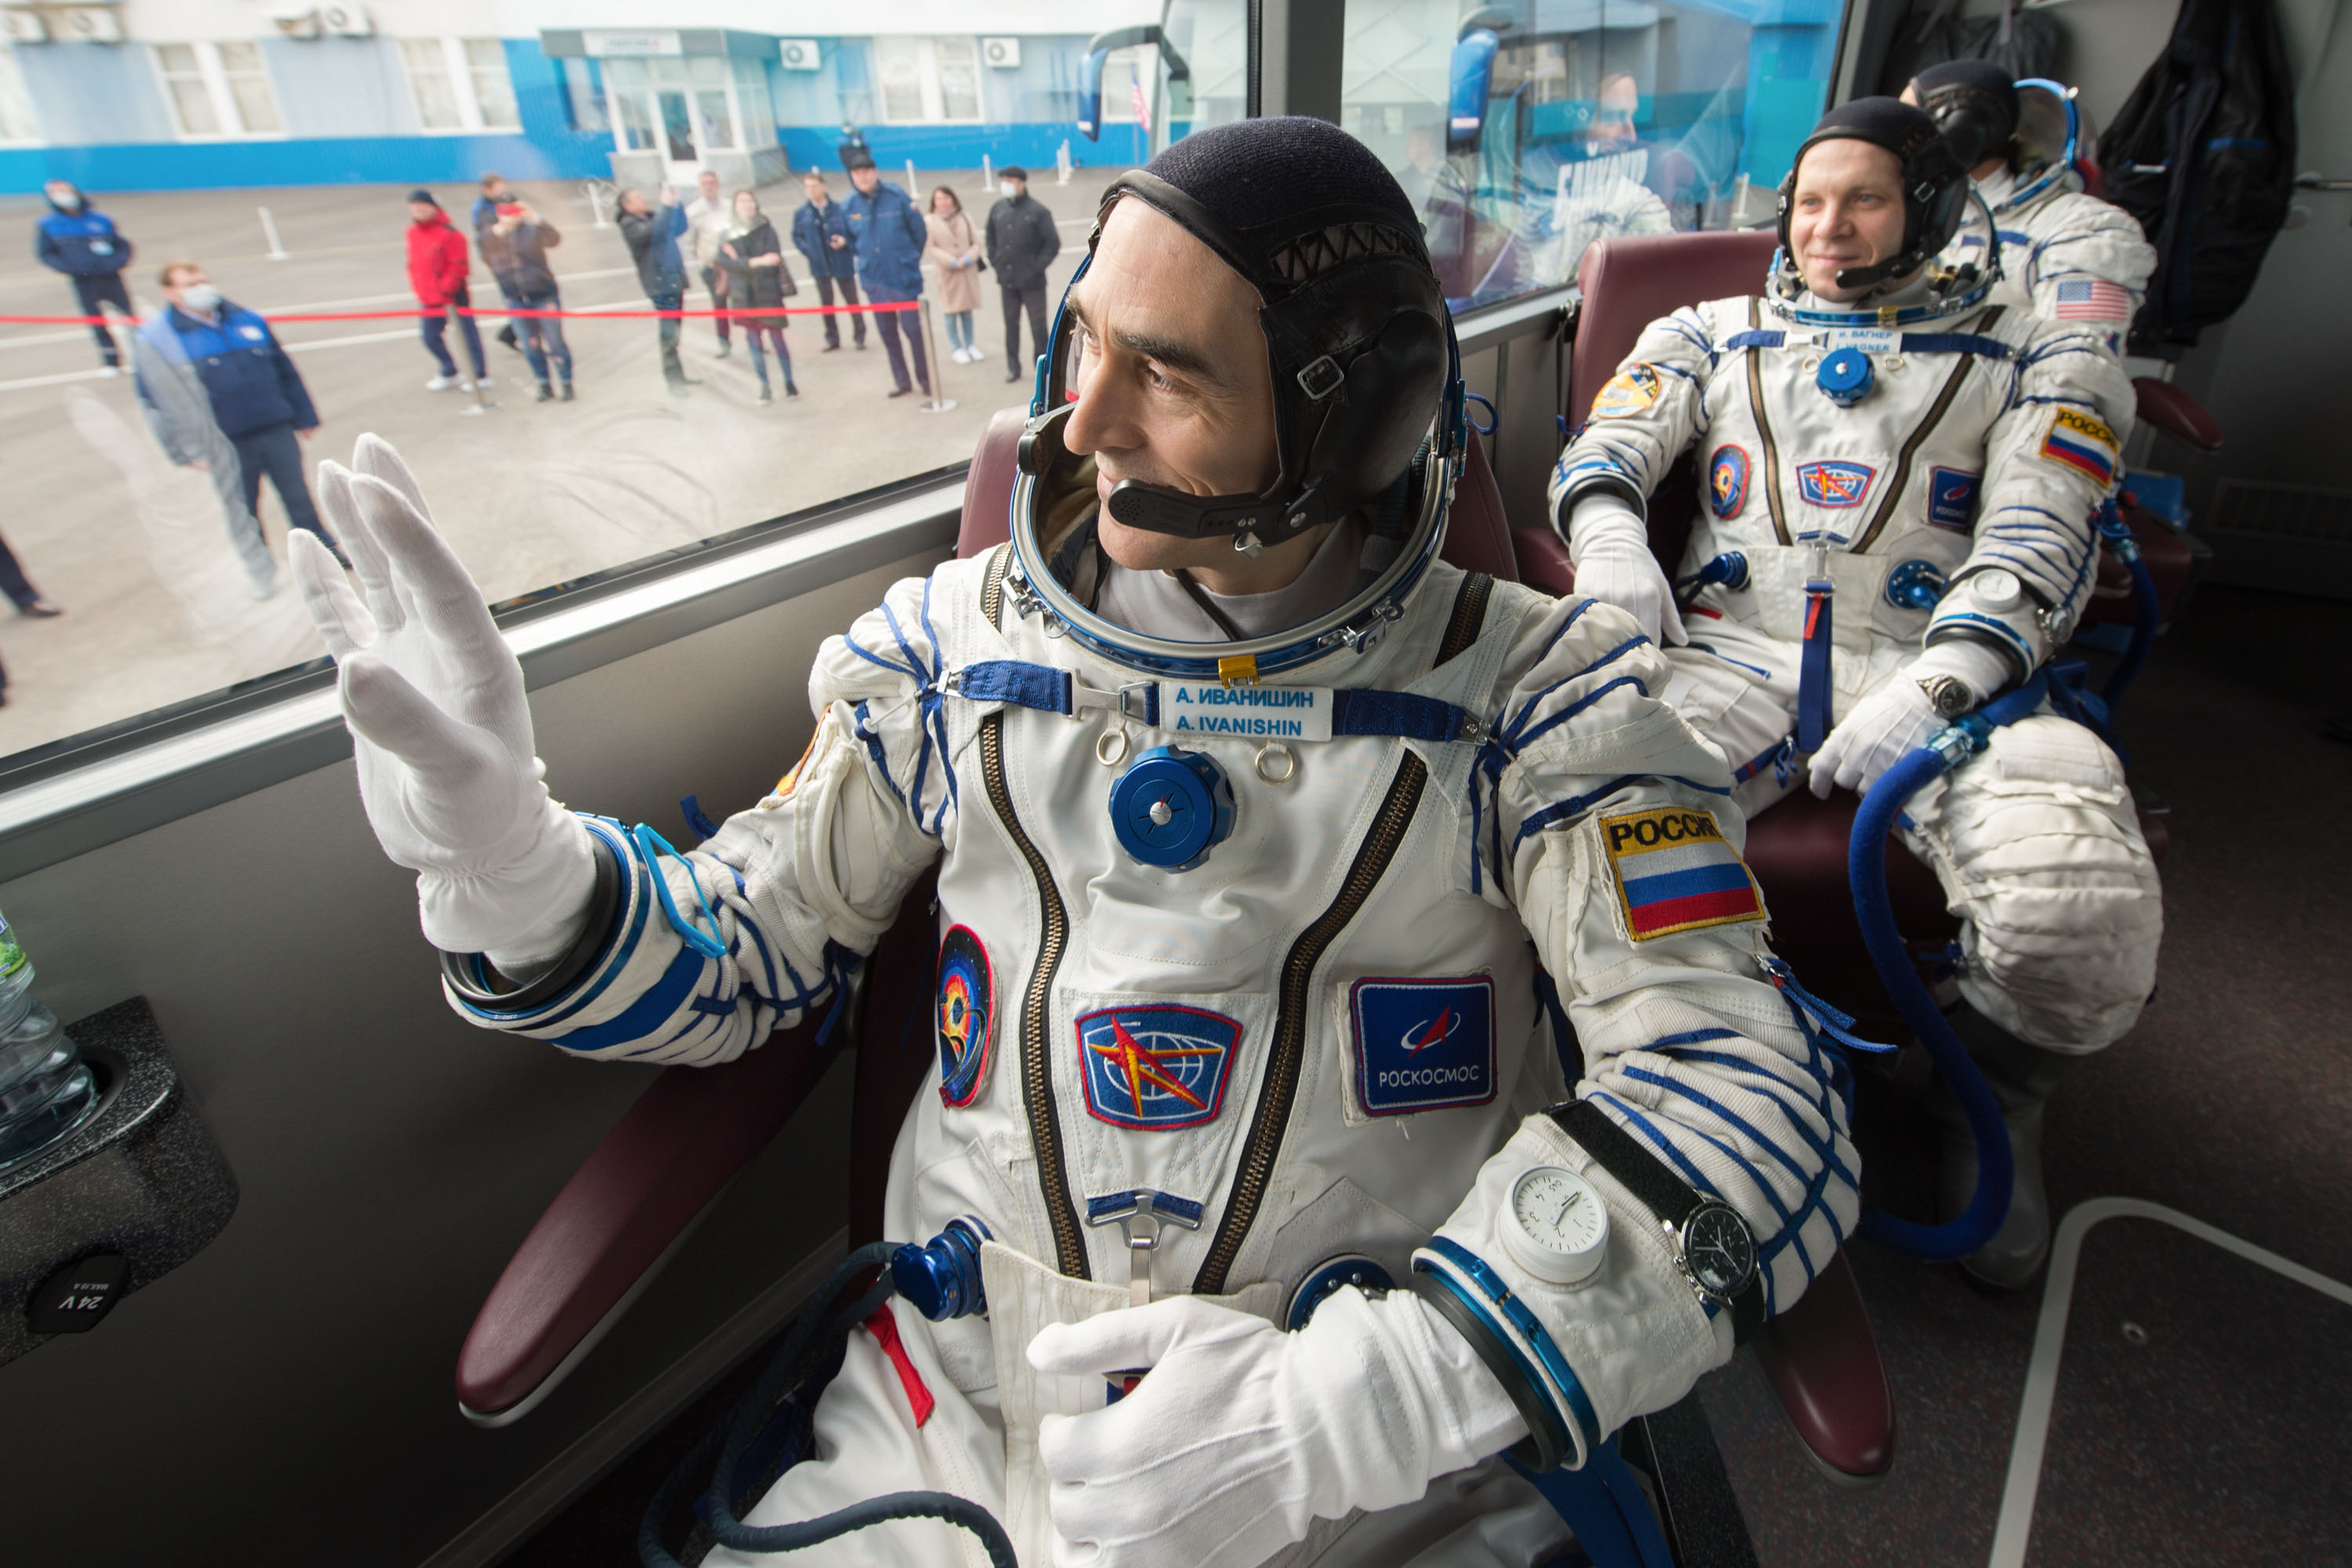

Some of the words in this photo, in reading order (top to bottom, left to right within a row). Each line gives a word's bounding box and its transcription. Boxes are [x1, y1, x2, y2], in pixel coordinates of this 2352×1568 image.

[1176, 688, 1193, 704] А.
[1199, 688, 1313, 707] ИВАНИШИН
[1177, 716, 1194, 730] A.
[1200, 717, 1301, 736] IVANISHIN
[1380, 1065, 1480, 1088] РОСКОСМОС
[58, 1295, 75, 1309] V
[77, 1295, 104, 1309] 24
